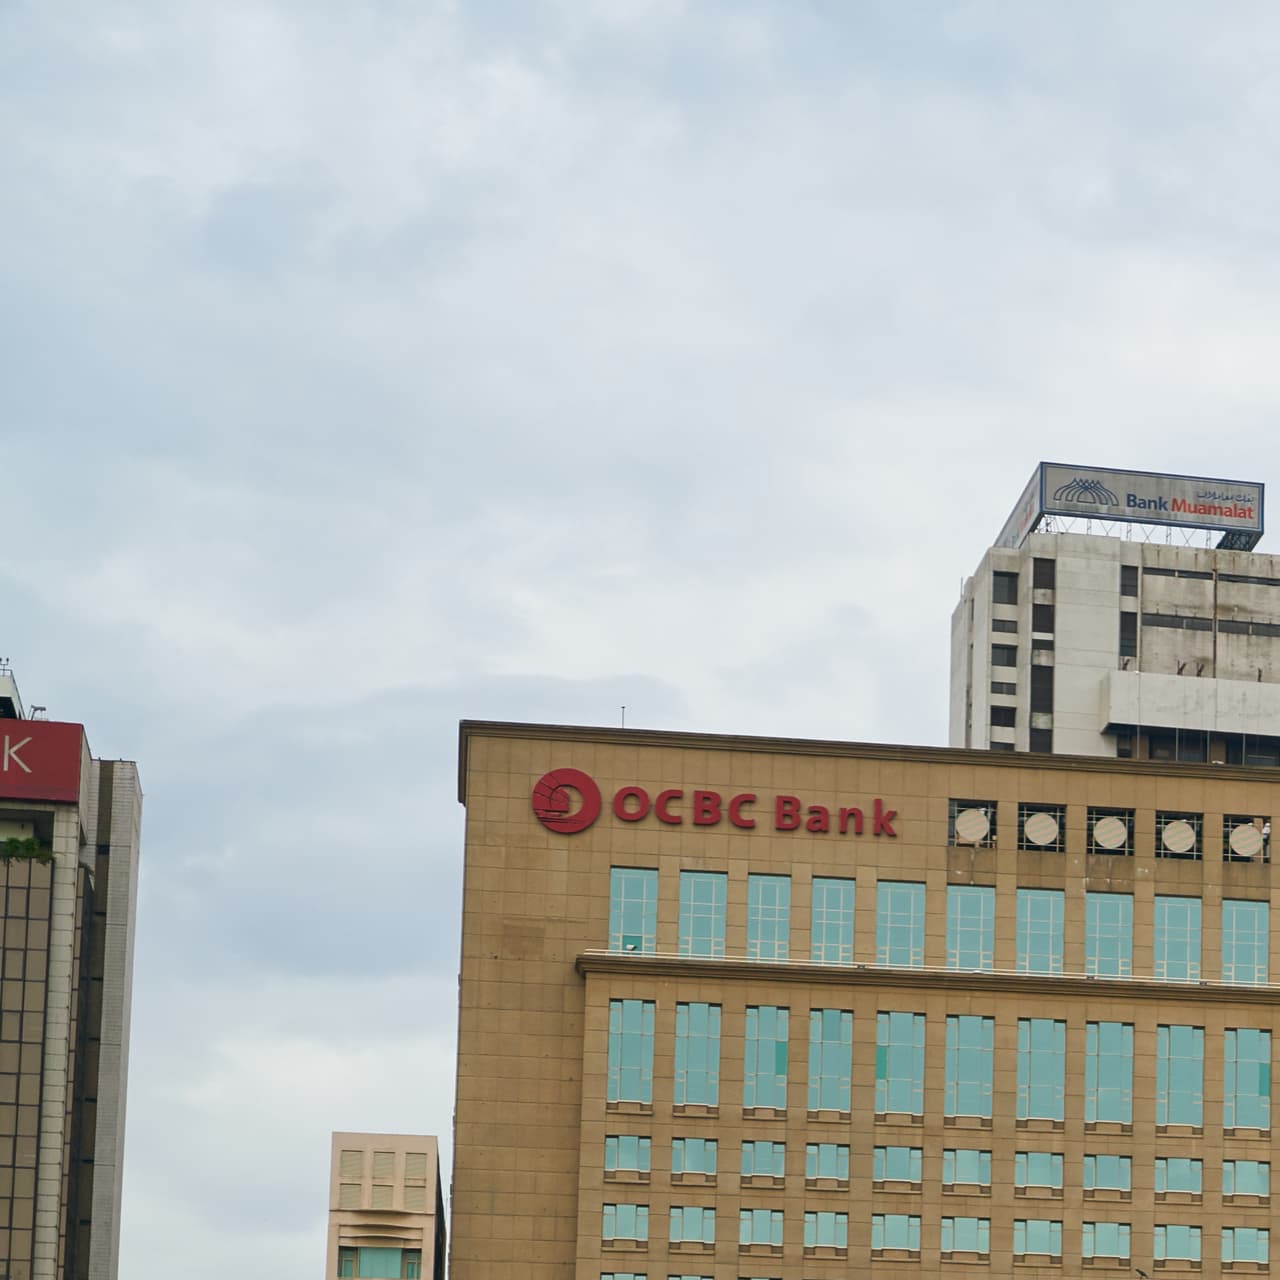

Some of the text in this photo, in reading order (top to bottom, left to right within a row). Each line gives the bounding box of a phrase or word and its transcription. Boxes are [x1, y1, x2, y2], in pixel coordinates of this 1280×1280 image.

[1126, 493, 1254, 520] Bank Muamalat
[613, 786, 898, 837] OCBC Bank
